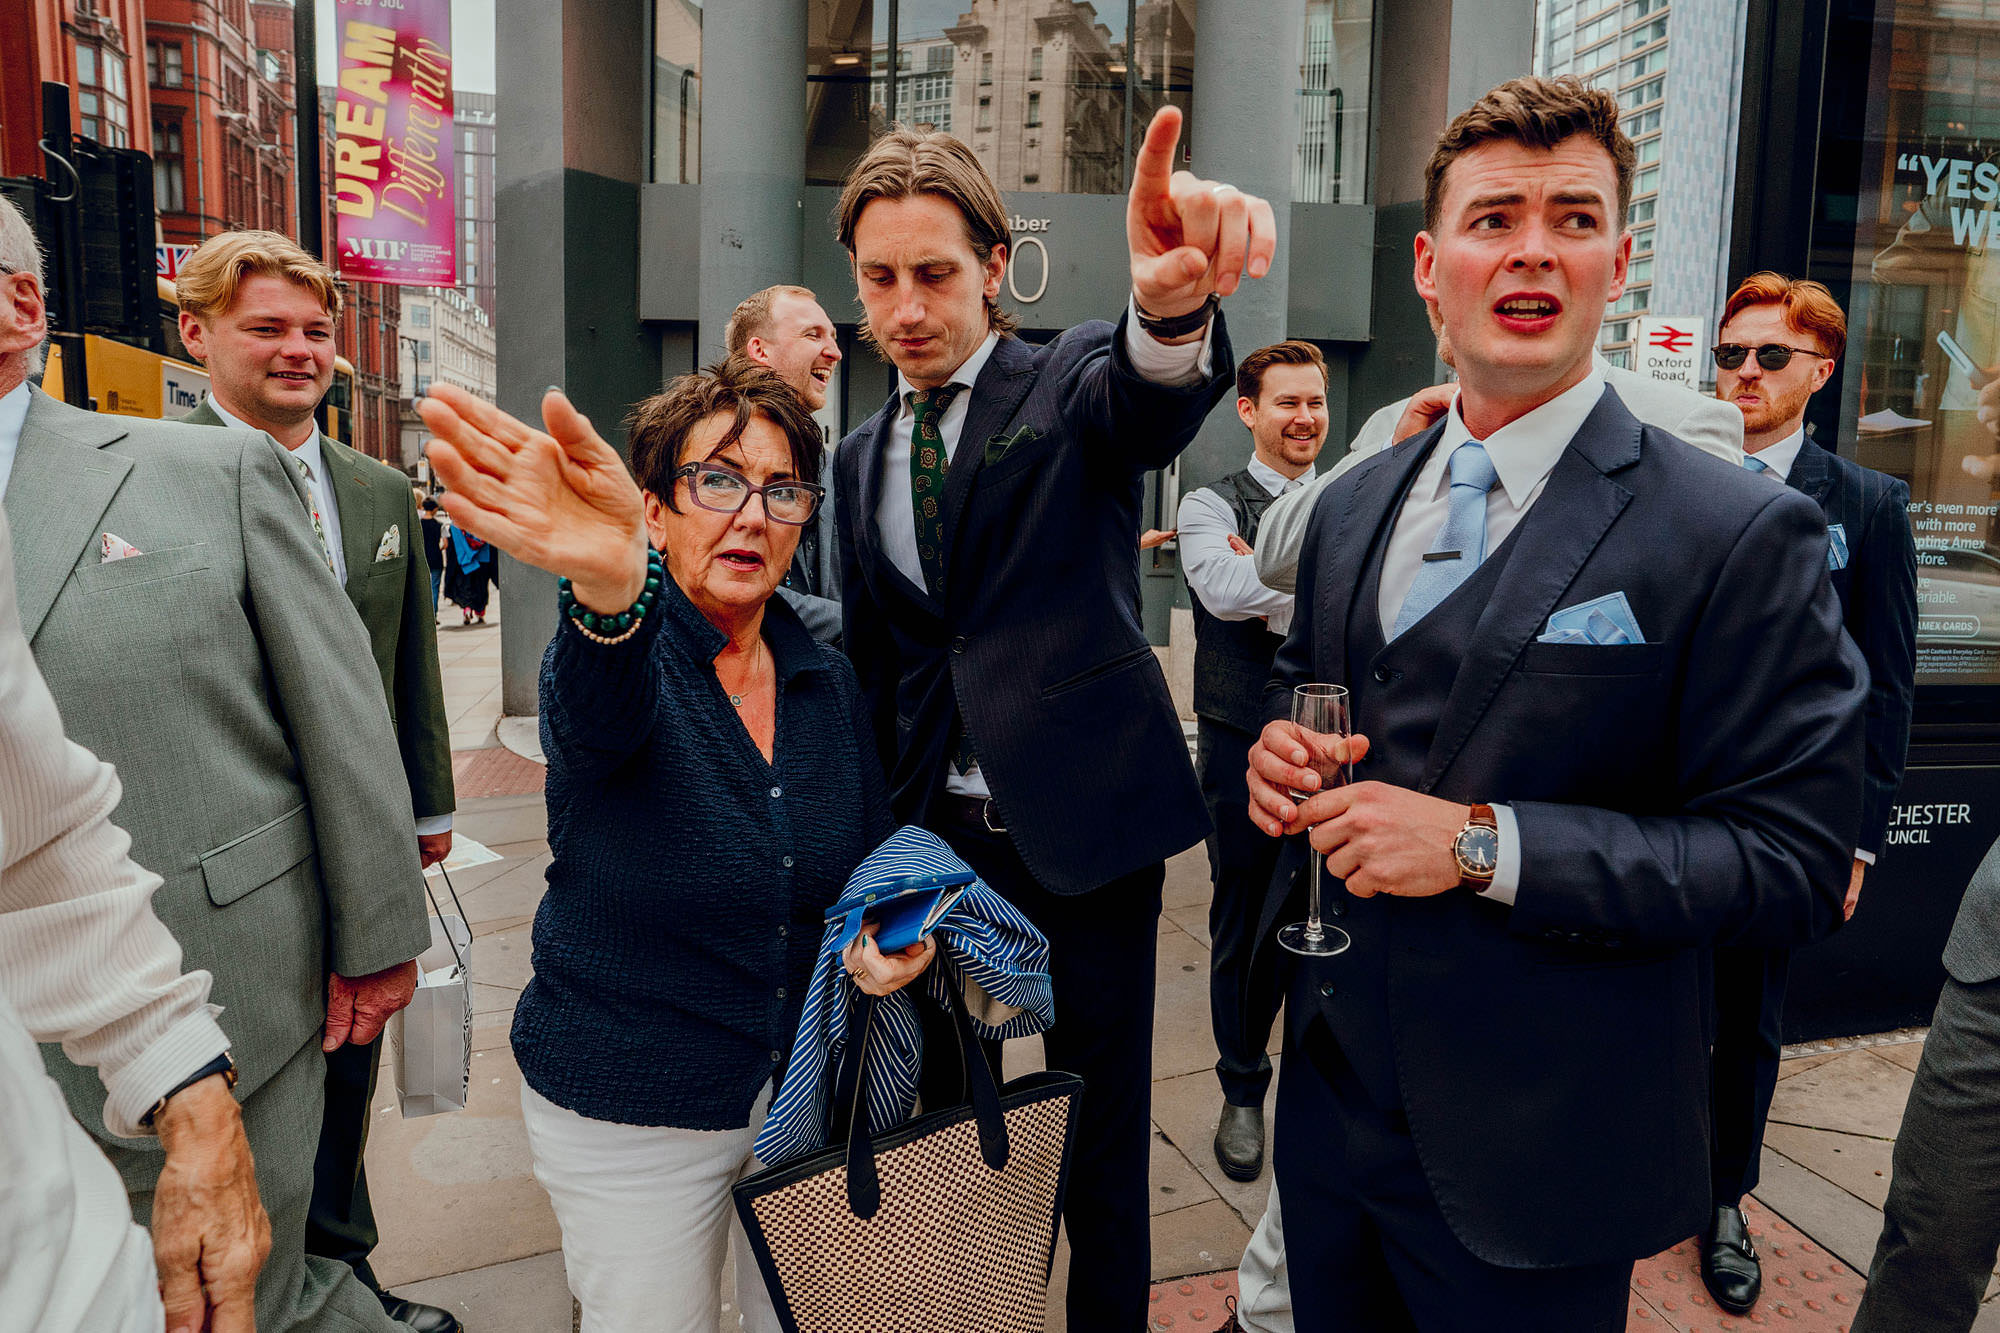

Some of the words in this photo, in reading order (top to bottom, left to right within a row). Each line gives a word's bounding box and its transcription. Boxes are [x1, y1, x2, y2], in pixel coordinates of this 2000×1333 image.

[335, 20, 397, 220] DREAM
[378, 38, 453, 227] Differently
[1897, 153, 2000, 202] “YES
[1008, 214, 1051, 232] ber
[343, 237, 409, 261] MIF
[1007, 236, 1050, 304] 0
[1648, 357, 1692, 368] Oxford
[1652, 370, 1686, 381] Road
[1906, 500, 1932, 513] ter's
[1935, 503, 1963, 514] even
[1966, 505, 1998, 516] more
[1916, 518, 1942, 531] with
[1945, 521, 1976, 532] more
[1914, 536, 1949, 551] pting
[1951, 536, 1986, 549] Amex
[1916, 591, 1958, 604] ariable.
[1943, 621, 1974, 632] CARDS
[1887, 829, 1931, 845] UNCIL
